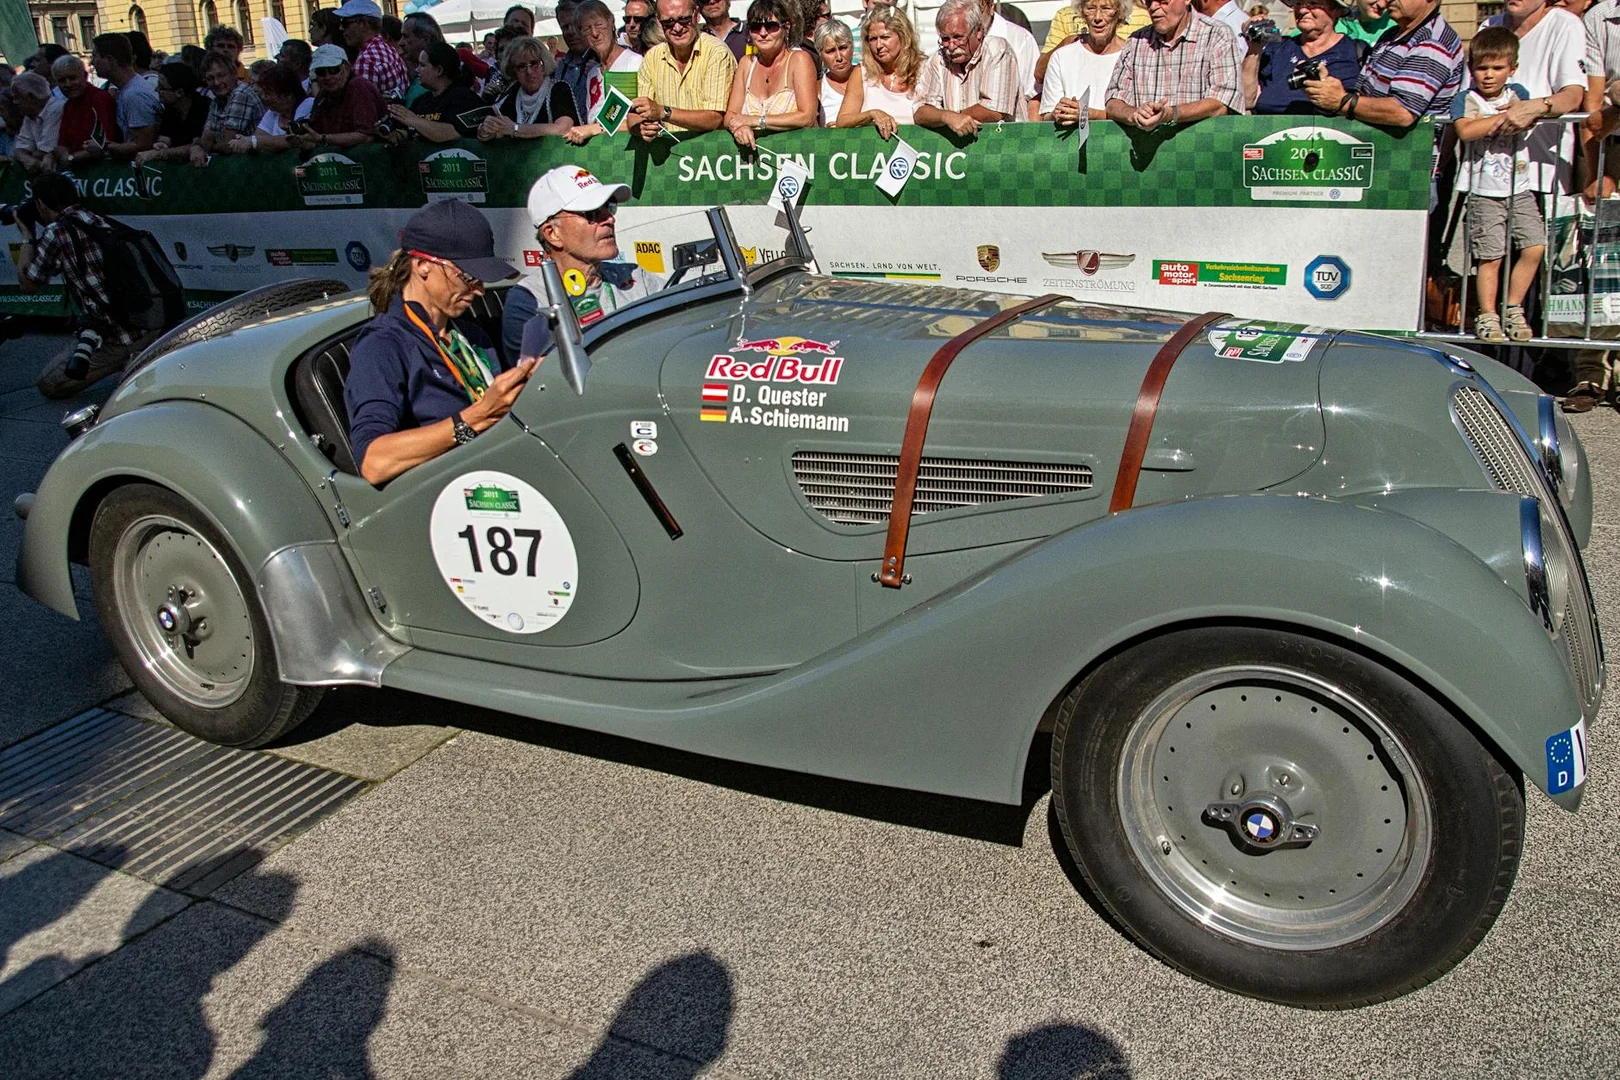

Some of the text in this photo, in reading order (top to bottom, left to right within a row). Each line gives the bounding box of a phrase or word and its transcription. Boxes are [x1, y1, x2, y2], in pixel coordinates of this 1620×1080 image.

[1290, 147, 1324, 160] 201
[442, 163, 461, 173] 2011
[829, 152, 967, 179] CLASIC
[318, 167, 338, 177] 2011
[1251, 164, 1364, 181] SACHSEN CLASSIC
[334, 178, 362, 191] CLASSIC
[456, 175, 484, 189] CLASSIC
[636, 243, 660, 254] ADAC
[829, 261, 870, 269] SACHSEN.
[872, 262, 893, 270] LAND
[1160, 263, 1189, 272] auto
[956, 275, 1028, 284] PORSCHE
[1219, 273, 1265, 283] Sachsenring
[1315, 271, 1339, 281] TÜV
[1042, 278, 1135, 291] ZEITENSTRÖMUNG
[706, 355, 844, 384] Red Bull
[733, 384, 827, 407] D. Quester
[483, 490, 499, 499] 2011
[495, 500, 517, 510] CLASSIC
[457, 525, 542, 577] 187
[1558, 770, 1568, 787] D
